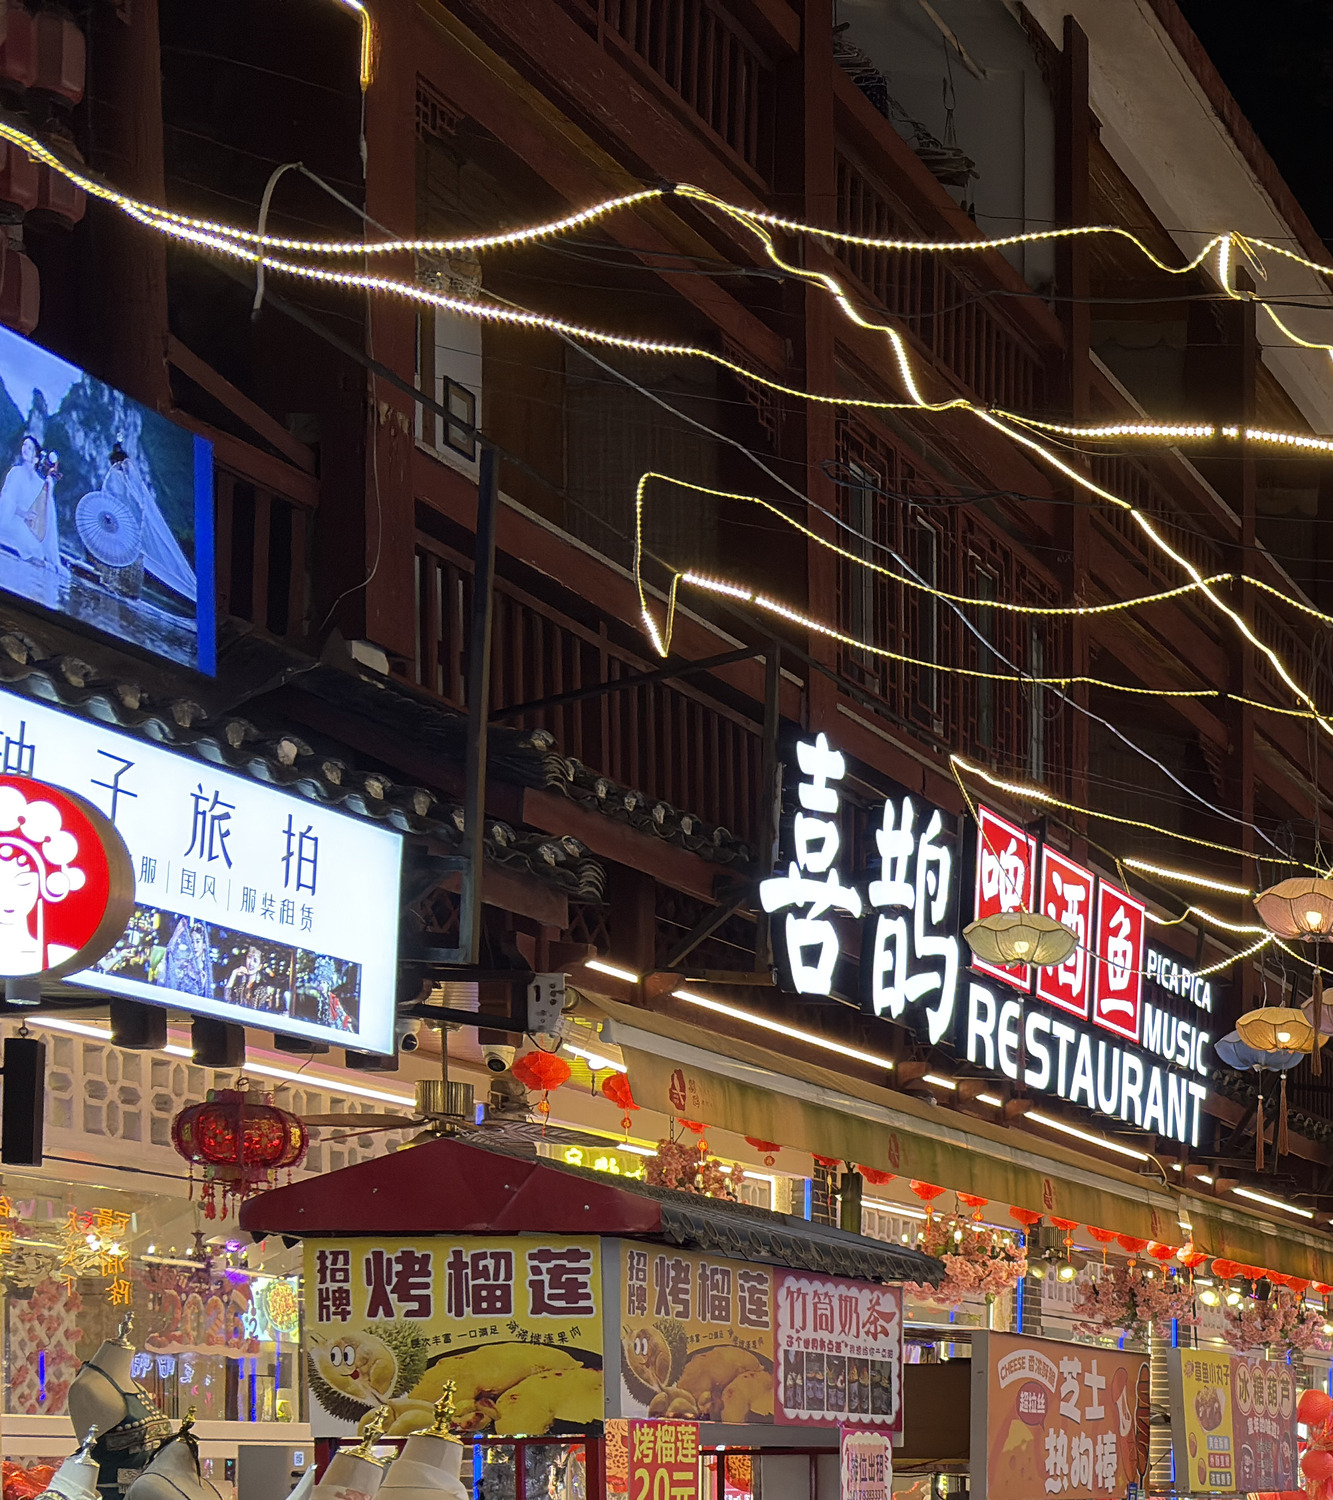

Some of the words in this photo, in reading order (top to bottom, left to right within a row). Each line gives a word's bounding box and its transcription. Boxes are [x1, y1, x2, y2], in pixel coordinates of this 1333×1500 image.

[179, 867, 218, 904] 国风
[239, 885, 315, 934] 服装租赁
[760, 732, 960, 1046] 喜鹊
[1147, 948, 1179, 998] PICA
[1181, 970, 1212, 1014] PICA
[966, 982, 1206, 1148] RESTAURANT
[1142, 1002, 1210, 1077] MUSIC
[316, 1248, 353, 1324] 招牌
[364, 1246, 596, 1320] 烤榴莲
[628, 1250, 648, 1317] 招牌
[653, 1254, 772, 1331] 烤榴莲
[785, 1284, 896, 1342] 竹筒奶茶
[457, 1324, 500, 1340] 一口满足
[999, 1355, 1026, 1381] CHEESE
[1059, 1355, 1107, 1425] 芝士
[1194, 1360, 1231, 1387] 章鱼小丸子
[1237, 1370, 1291, 1409] 冰糖葫芦
[633, 1422, 697, 1465] 烤榴莲
[1044, 1427, 1118, 1495] 热狗棒
